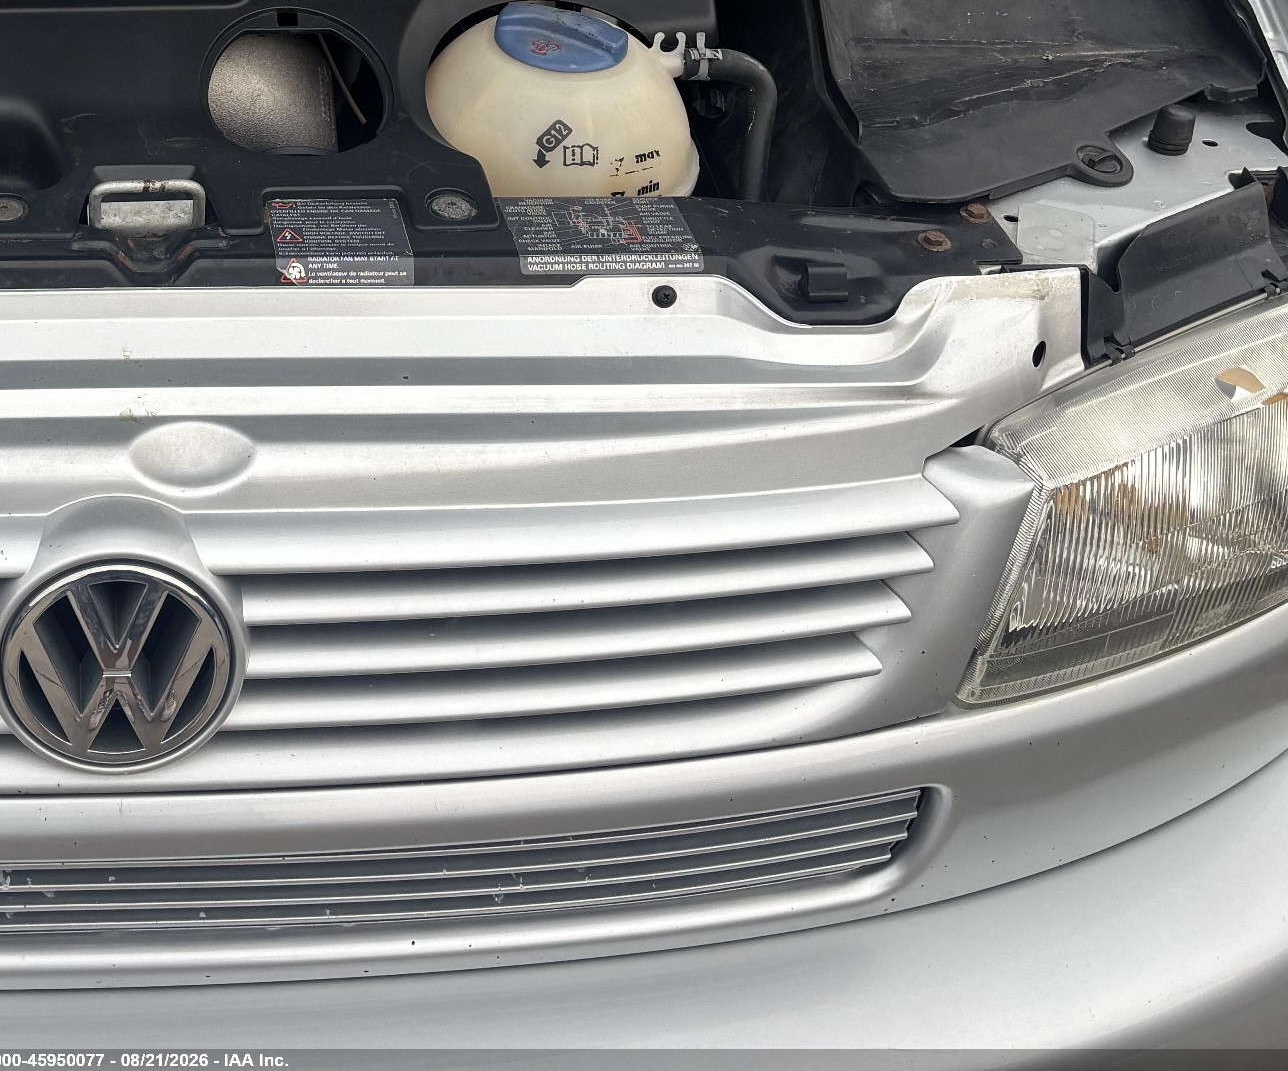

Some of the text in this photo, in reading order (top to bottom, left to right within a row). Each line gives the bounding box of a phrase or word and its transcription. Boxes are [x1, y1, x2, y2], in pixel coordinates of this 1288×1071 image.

[542, 123, 569, 148] G12
[635, 150, 661, 164] max
[637, 180, 660, 196] min
[527, 255, 580, 263] ANORDNUNG
[527, 263, 563, 271] VACUUM
[588, 262, 626, 270] ROUTING
[1, 565, 229, 763] VW
